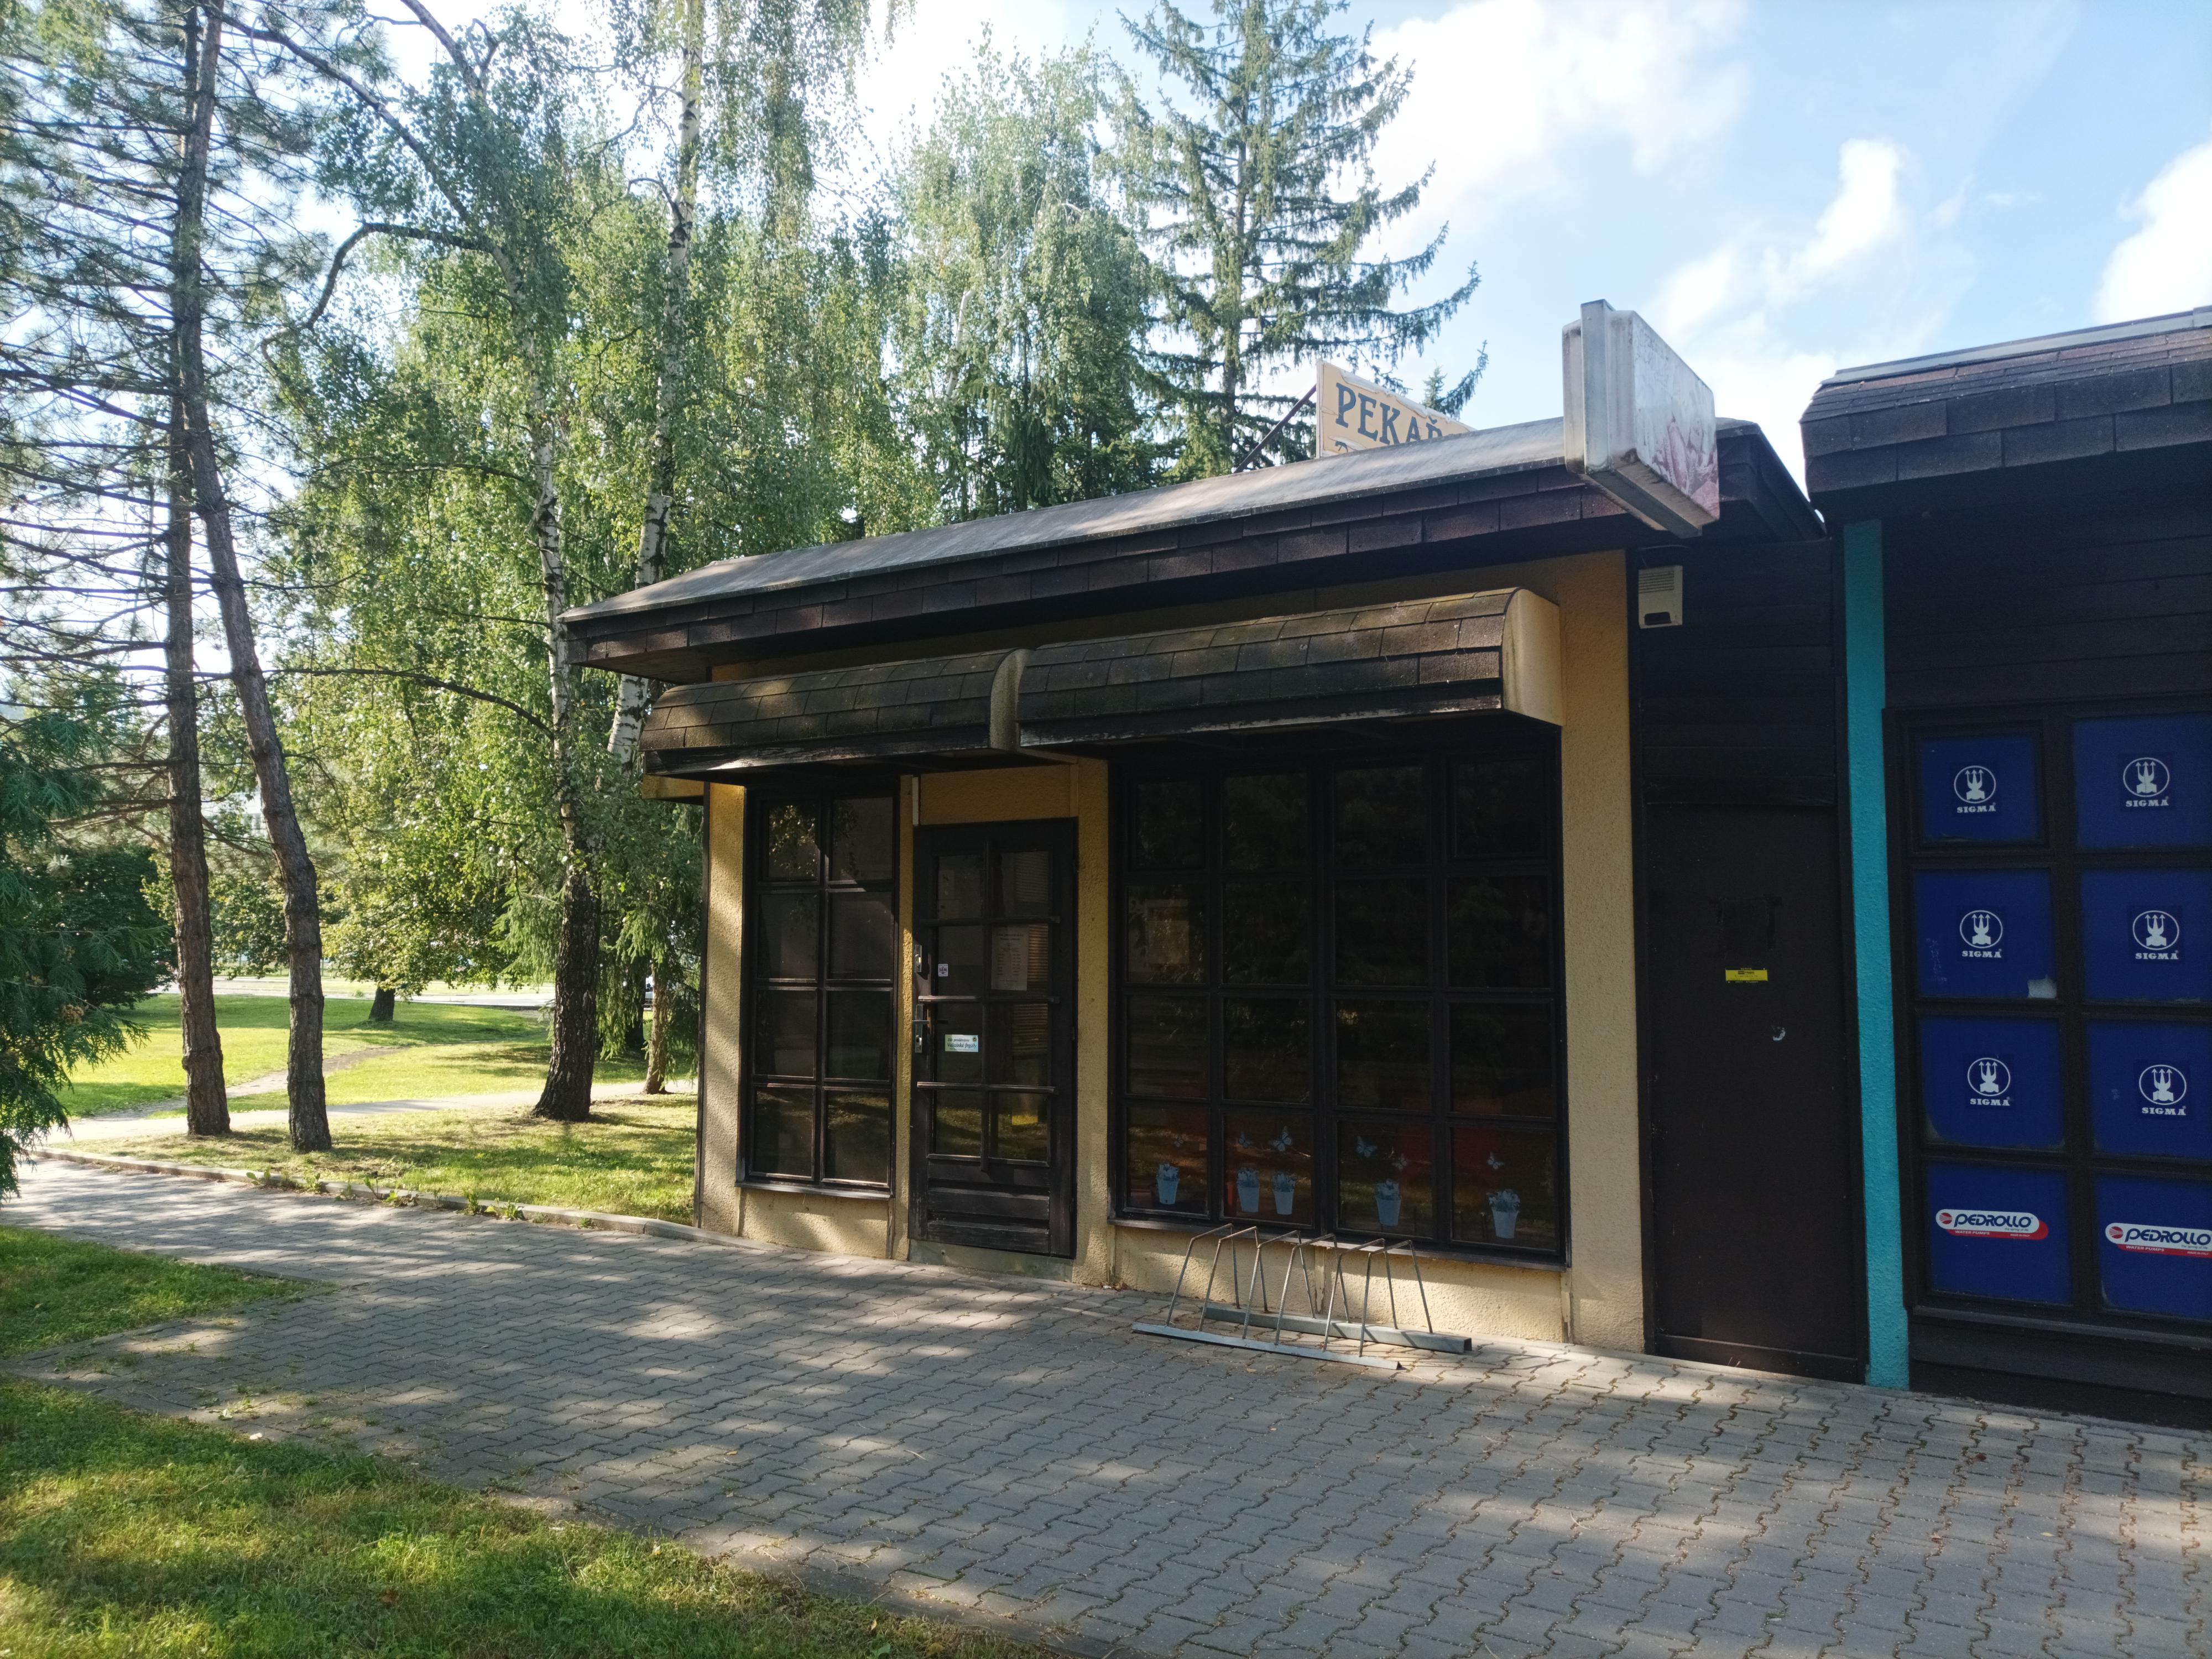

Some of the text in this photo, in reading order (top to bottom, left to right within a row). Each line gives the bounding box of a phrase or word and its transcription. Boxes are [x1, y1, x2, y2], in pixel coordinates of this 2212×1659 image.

[2126, 799, 2169, 807] SIGMA
[1957, 805, 1996, 813] SIGMA
[1961, 950, 2002, 958] SIGMA
[2135, 951, 2178, 960] SIGMA
[1970, 1098, 2010, 1106] SIGMA
[2142, 1107, 2186, 1115] SIGMA
[1954, 1213, 2032, 1228] PEDROLLO
[2125, 1228, 2211, 1246] PEDROLLO
